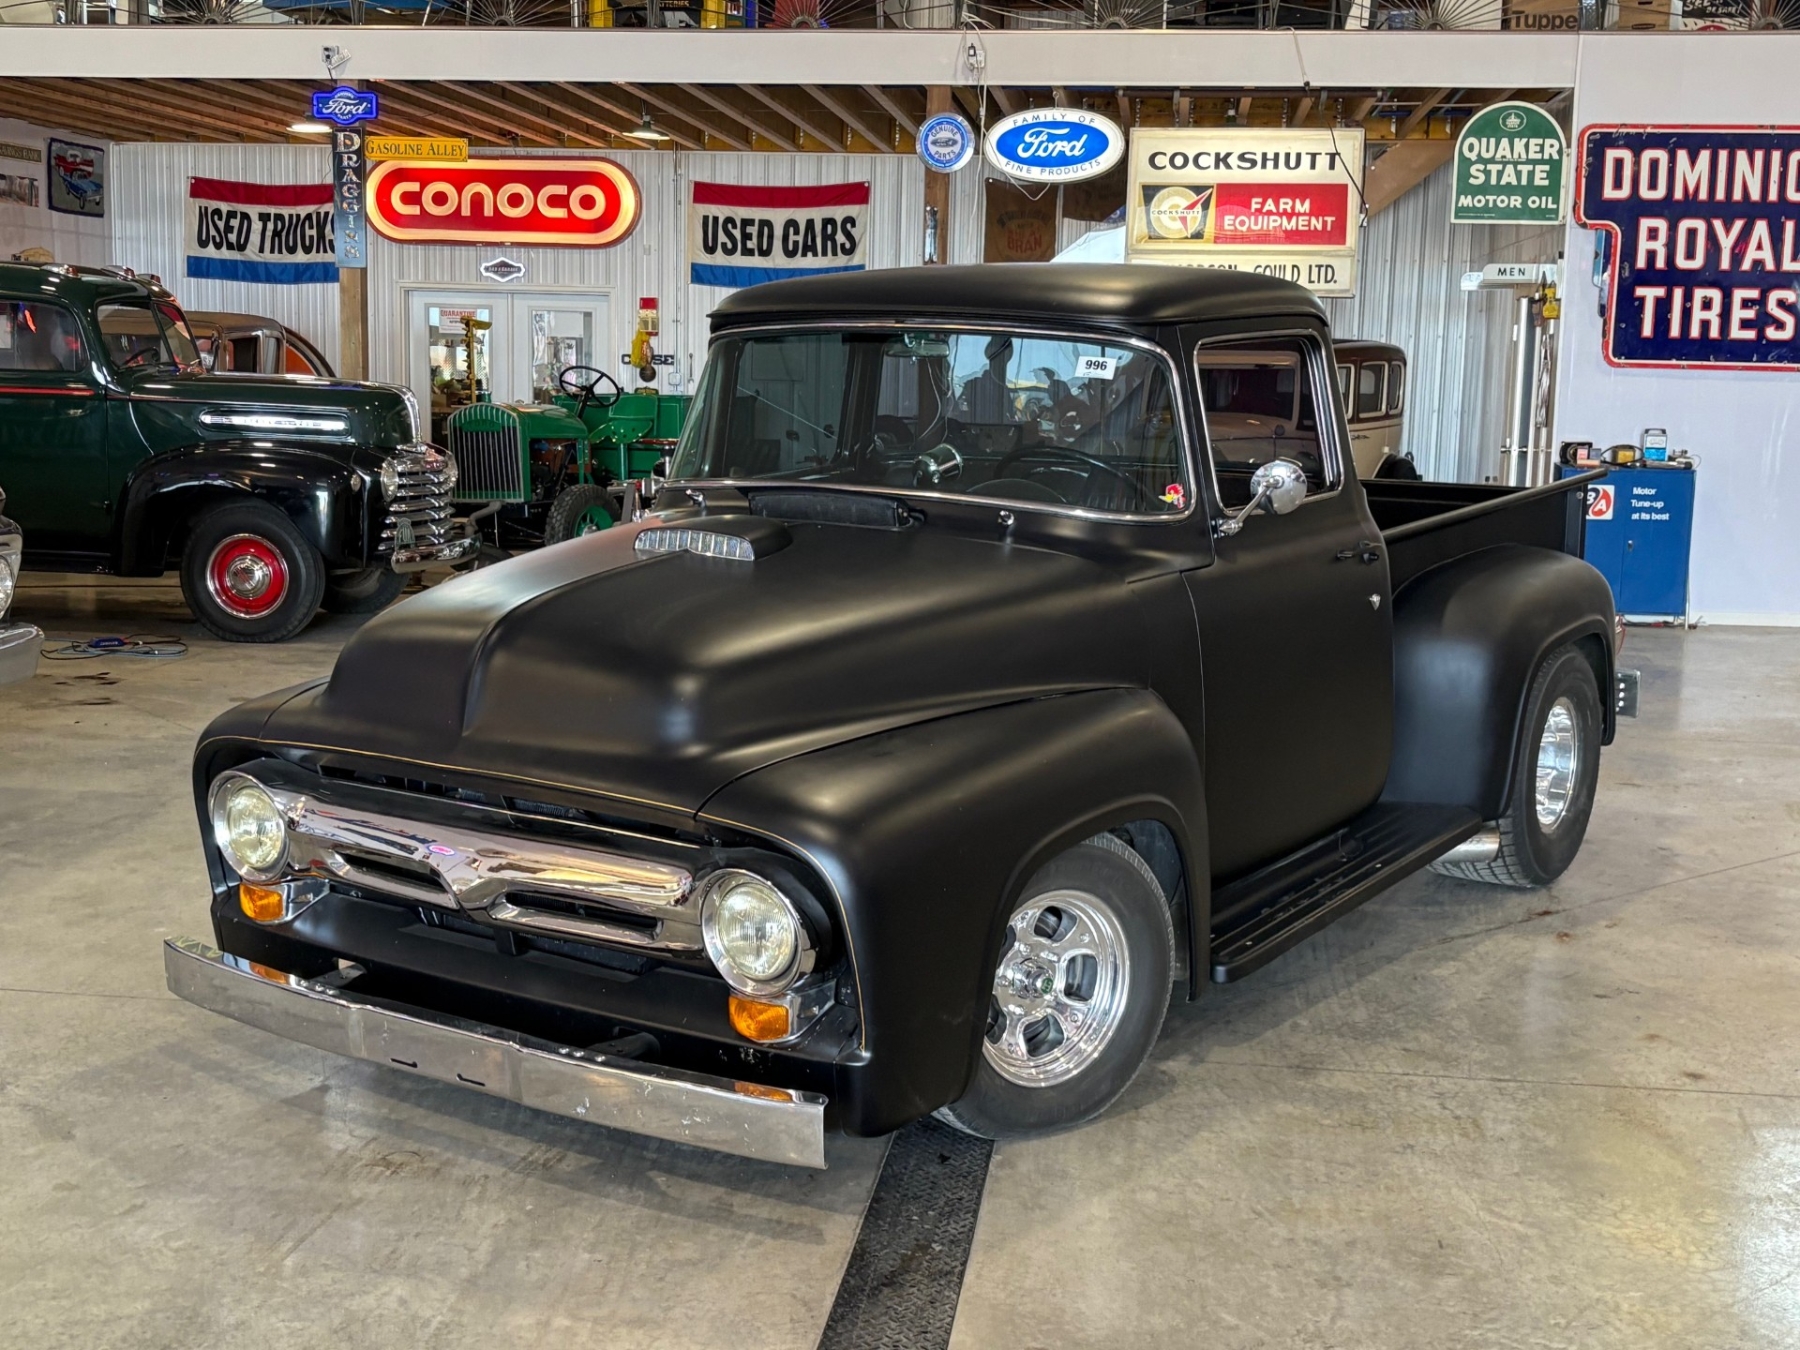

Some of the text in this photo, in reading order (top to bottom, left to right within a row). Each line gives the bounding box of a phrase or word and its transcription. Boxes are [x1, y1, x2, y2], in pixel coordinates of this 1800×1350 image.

[1512, 10, 1578, 30] Tuppe
[322, 98, 367, 114] Ford
[1013, 113, 1096, 127] FAMILY OF
[931, 125, 958, 137] GENUINE
[366, 140, 465, 157] GASOLINE ALLEY
[1017, 127, 1088, 158] Ford
[1462, 137, 1560, 161] QUAKER
[934, 149, 956, 159] PARTS
[1148, 151, 1341, 171] COCKSHUTT
[1005, 159, 1101, 176] FINE PRODUCTS
[1468, 163, 1550, 186] STATE
[1251, 198, 1310, 213] FARM
[1458, 195, 1557, 209] MOTOR OIL
[197, 206, 252, 252] USED
[1223, 216, 1335, 231] EQUIPMENT
[702, 215, 857, 257] USED CARS
[1635, 216, 1800, 273] ROYAL
[1308, 264, 1337, 284] LTD.
[1497, 267, 1526, 277] MEN
[1634, 286, 1797, 340] TIRES
[621, 354, 674, 365] CSE
[1085, 360, 1108, 371] 996
[1632, 487, 1657, 495] Motor
[1631, 499, 1664, 510] Tune-up
[1640, 512, 1650, 520] its
[1651, 512, 1670, 520] best
